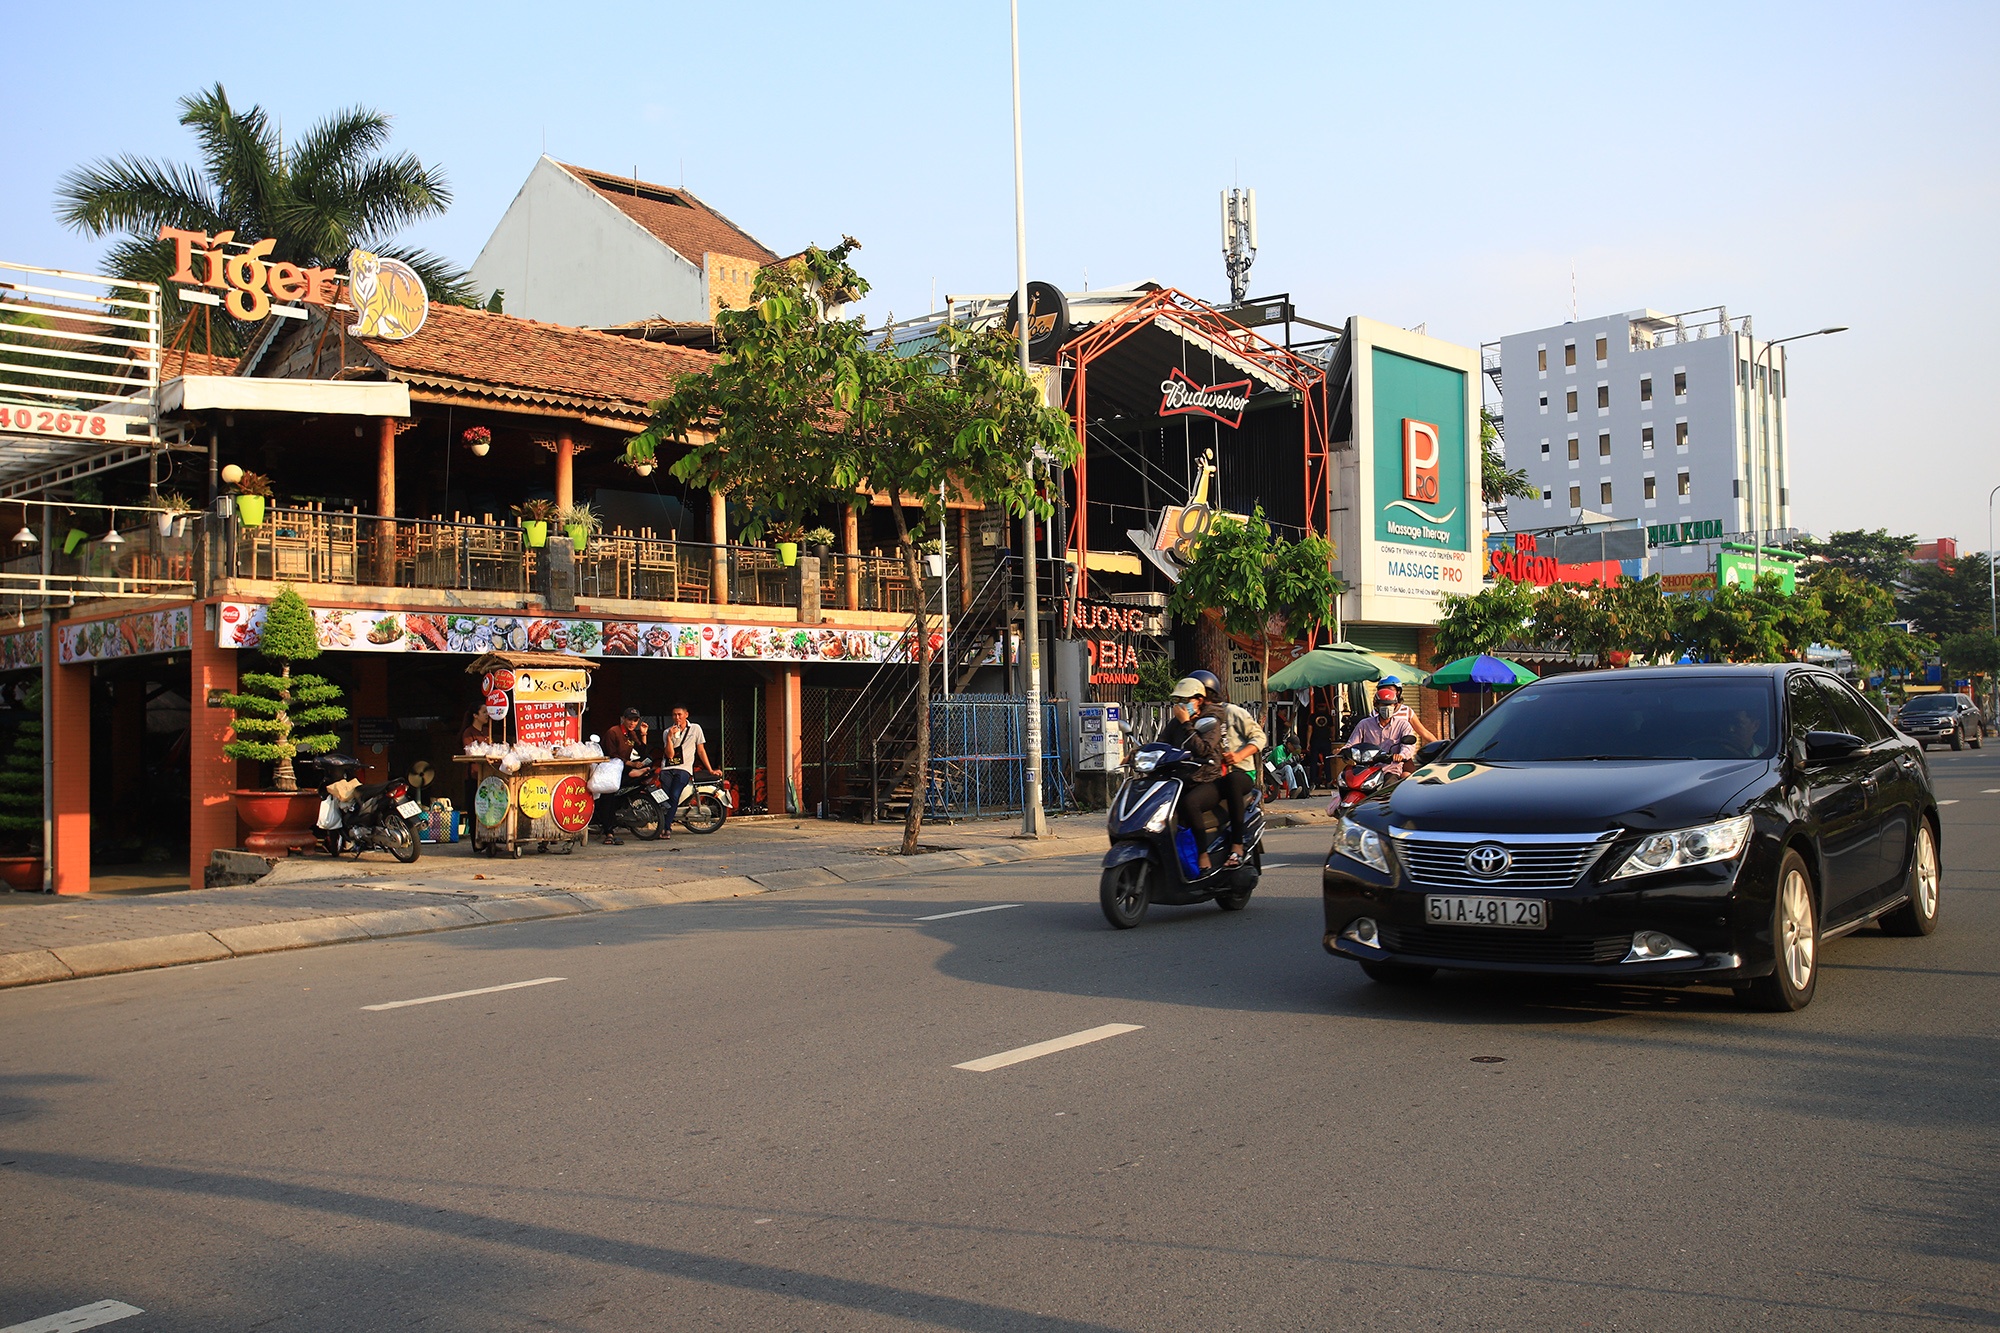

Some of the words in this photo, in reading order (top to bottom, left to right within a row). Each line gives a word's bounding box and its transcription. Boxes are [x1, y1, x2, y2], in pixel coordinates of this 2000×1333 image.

[158, 226, 336, 322] Tiger
[1161, 380, 1249, 411] Budweiser
[1387, 521, 1421, 540] Massage
[1422, 526, 1450, 543] Therapy
[1515, 533, 1537, 552] BIA
[1648, 524, 1679, 543] NHA
[1682, 520, 1723, 541] KHOA
[1453, 552, 1466, 562] PRO
[1388, 561, 1439, 580] MASSAGE
[1443, 566, 1463, 583] PRO
[1099, 640, 1139, 669] BIA
[536, 786, 548, 794] 10K
[537, 801, 549, 810] 15K
